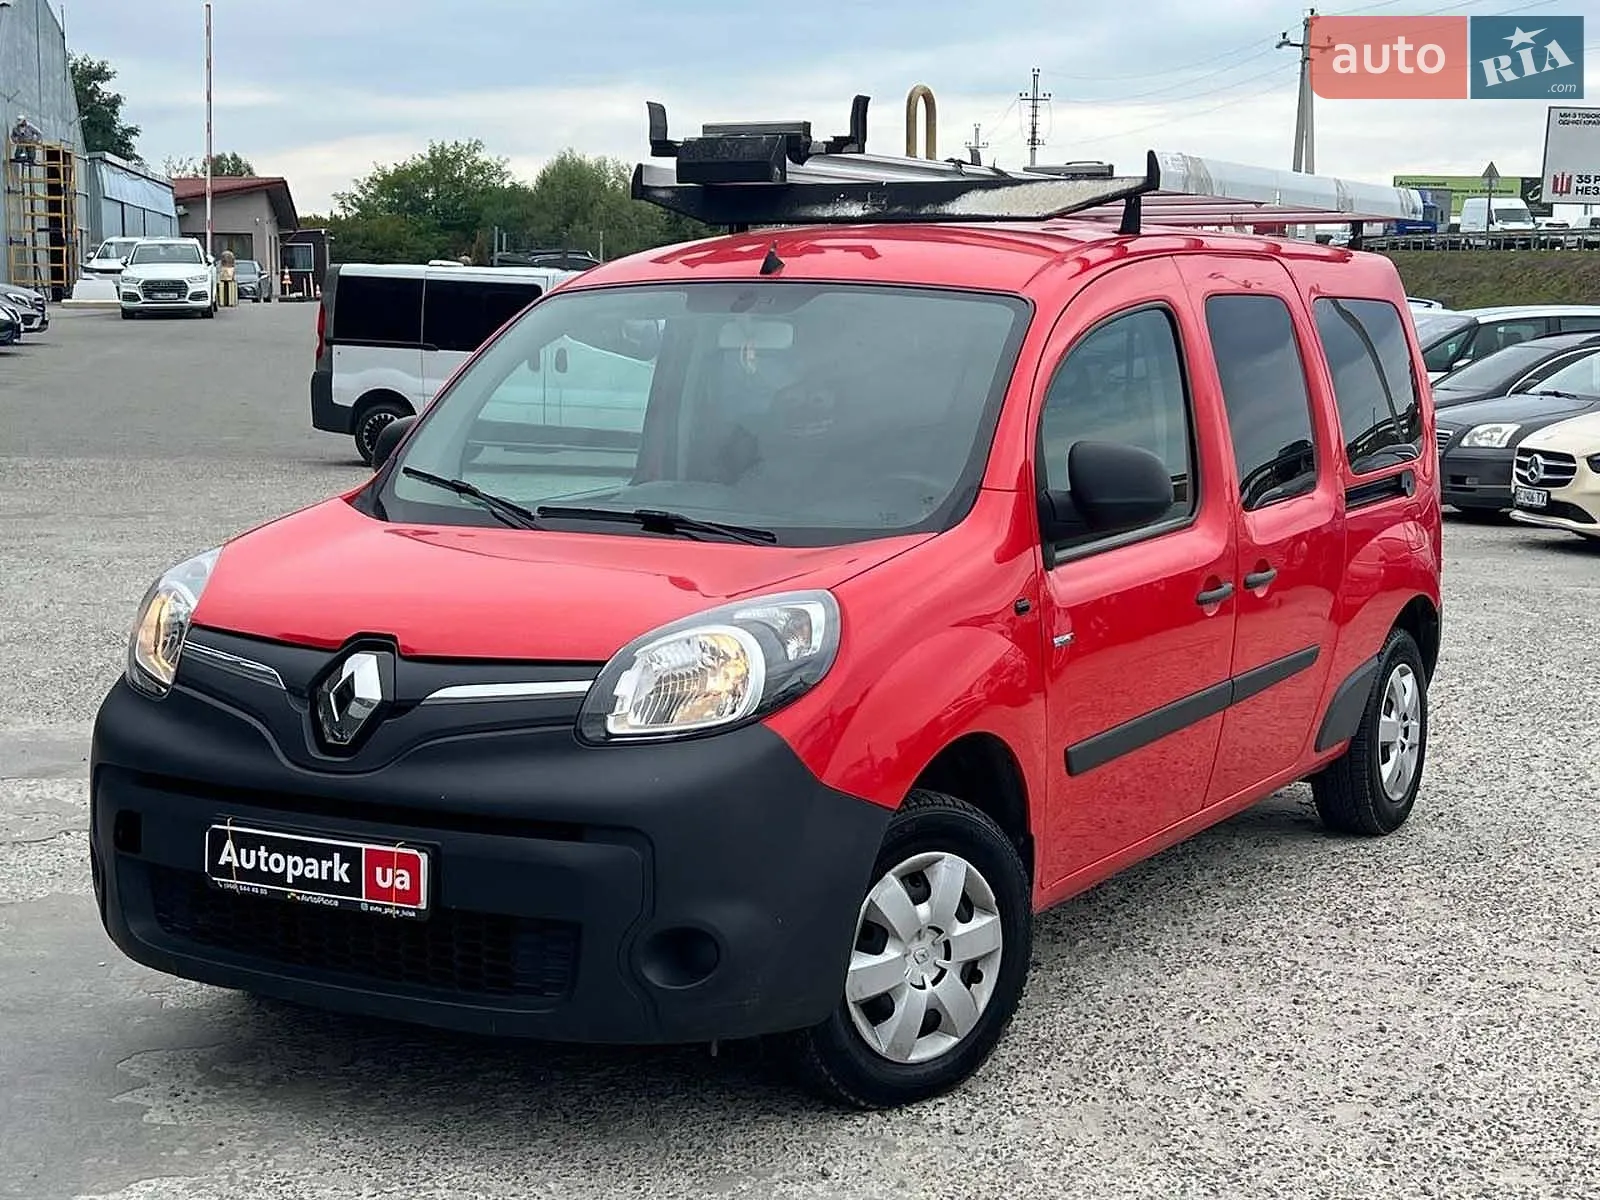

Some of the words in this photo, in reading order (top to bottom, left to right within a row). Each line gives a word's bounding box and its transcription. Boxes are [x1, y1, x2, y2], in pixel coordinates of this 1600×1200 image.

[1576, 174, 1592, 184] 35
[218, 839, 351, 884] Autopark
[375, 866, 411, 891] ua
